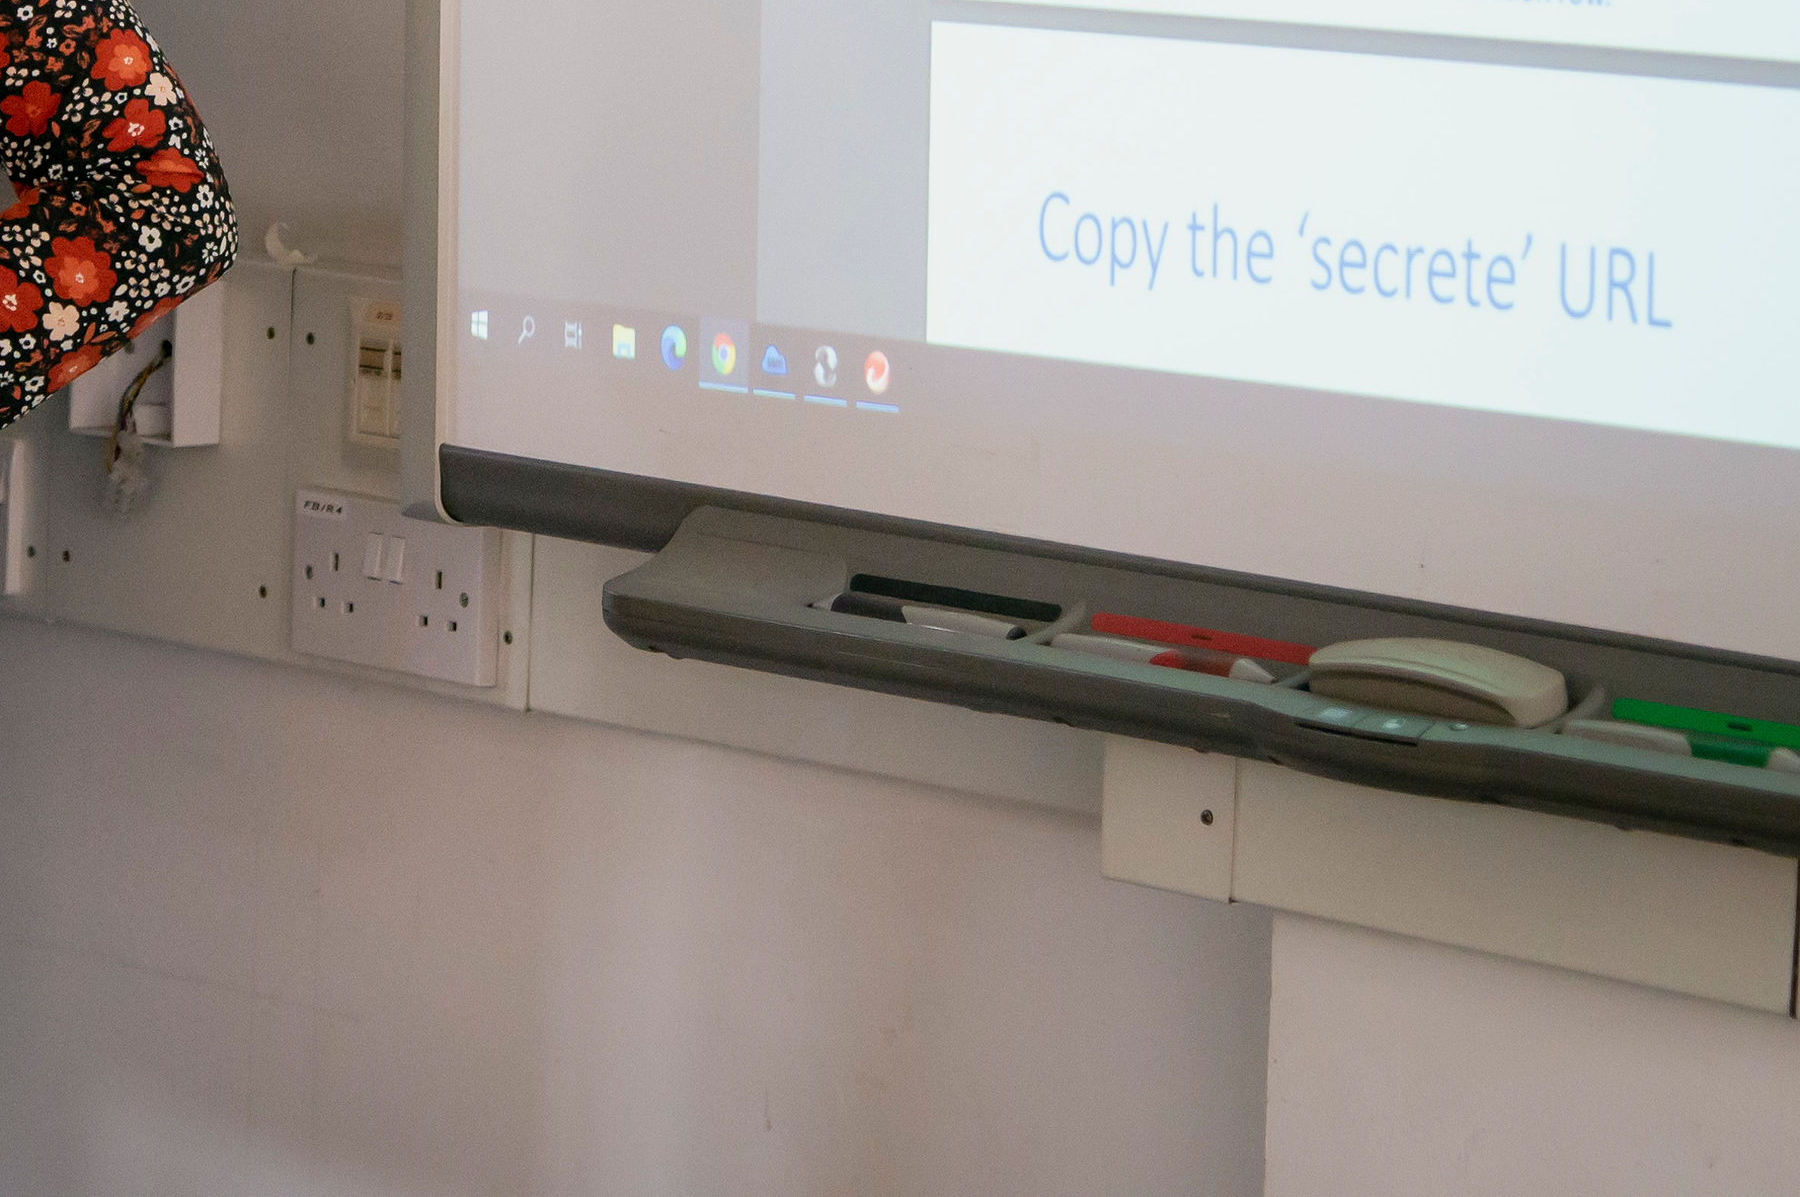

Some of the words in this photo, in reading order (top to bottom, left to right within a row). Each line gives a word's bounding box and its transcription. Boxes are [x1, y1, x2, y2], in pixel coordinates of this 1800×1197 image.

[1038, 190, 1170, 292] Copy
[1187, 202, 1275, 285] the
[1557, 241, 1674, 331] URL
